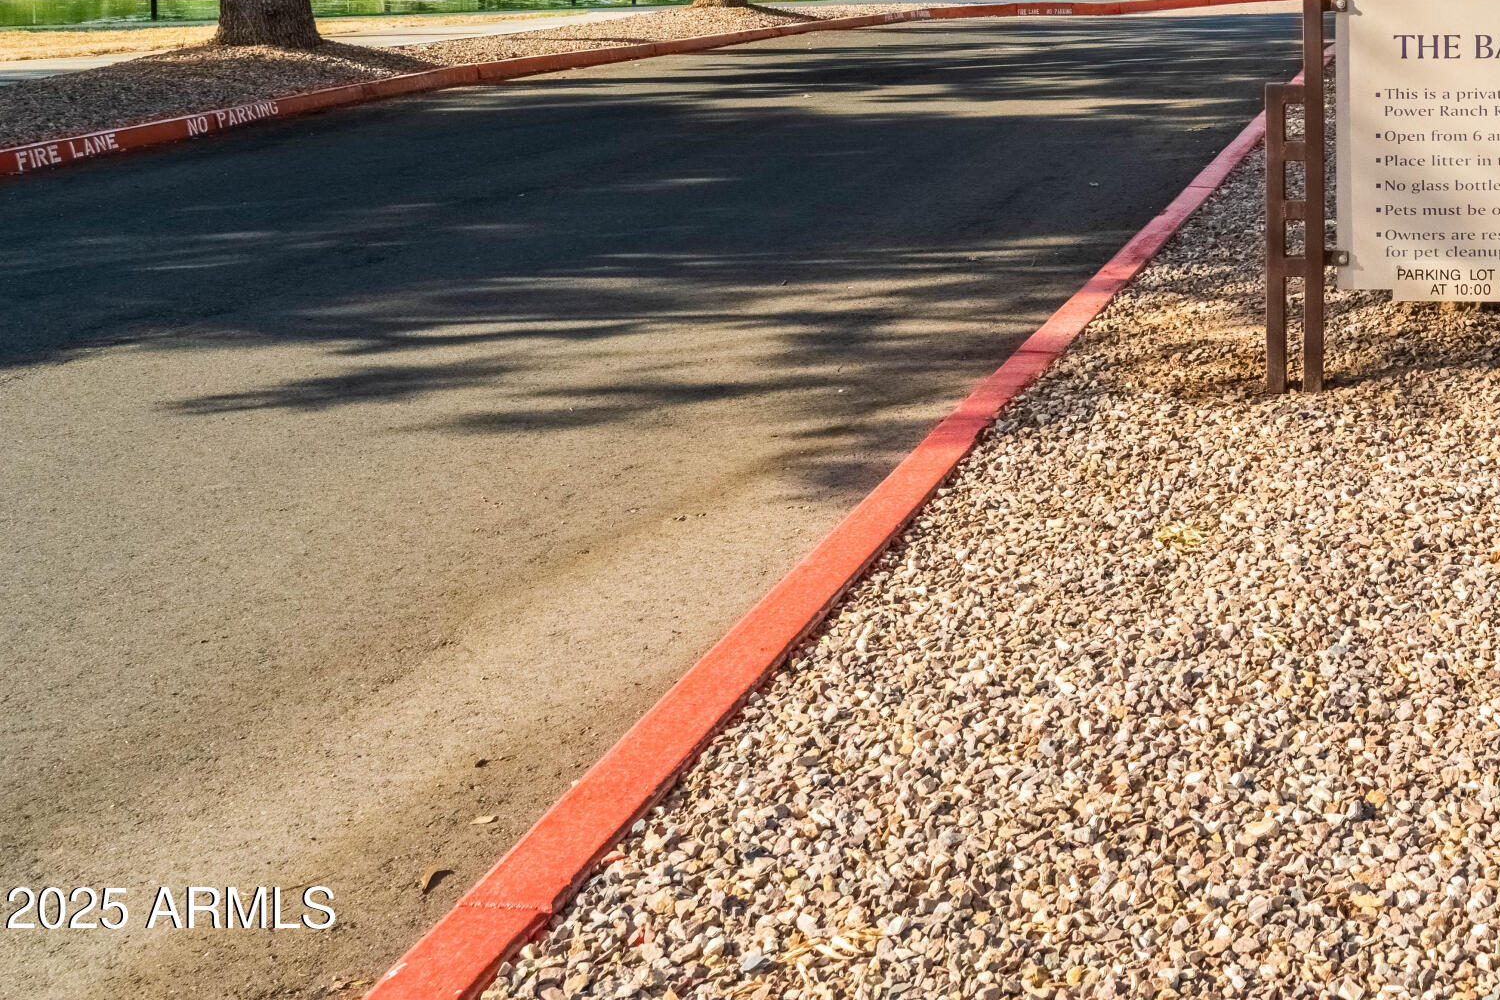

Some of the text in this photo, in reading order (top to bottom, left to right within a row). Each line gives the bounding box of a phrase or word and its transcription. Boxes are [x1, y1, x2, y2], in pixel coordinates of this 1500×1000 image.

[1393, 34, 1461, 59] THE
[1384, 88, 1418, 99] This
[1424, 88, 1436, 99] is
[1385, 106, 1435, 116] Power
[1440, 105, 1487, 116] Ranch
[187, 101, 279, 136] NO PARKING
[1384, 130, 1425, 144] Open
[1432, 130, 1467, 141] from
[1473, 131, 1482, 141] 6
[15, 133, 119, 171] FIRE LANE
[1385, 155, 1425, 166] Place
[1432, 155, 1471, 166] litter
[1477, 155, 1491, 166] in
[1385, 180, 1406, 191] No
[1411, 180, 1449, 194] glass
[1385, 205, 1416, 215] Pets
[1423, 206, 1462, 215] must
[1468, 204, 1486, 215] be
[1385, 229, 1445, 240] Owners
[1451, 232, 1476, 240] are
[1386, 246, 1408, 257] for
[1414, 248, 1439, 260] pet
[1397, 269, 1460, 281] PARKING
[1470, 269, 1495, 281] LOT
[1430, 283, 1447, 295] AT
[1454, 284, 1491, 295] 10:00
